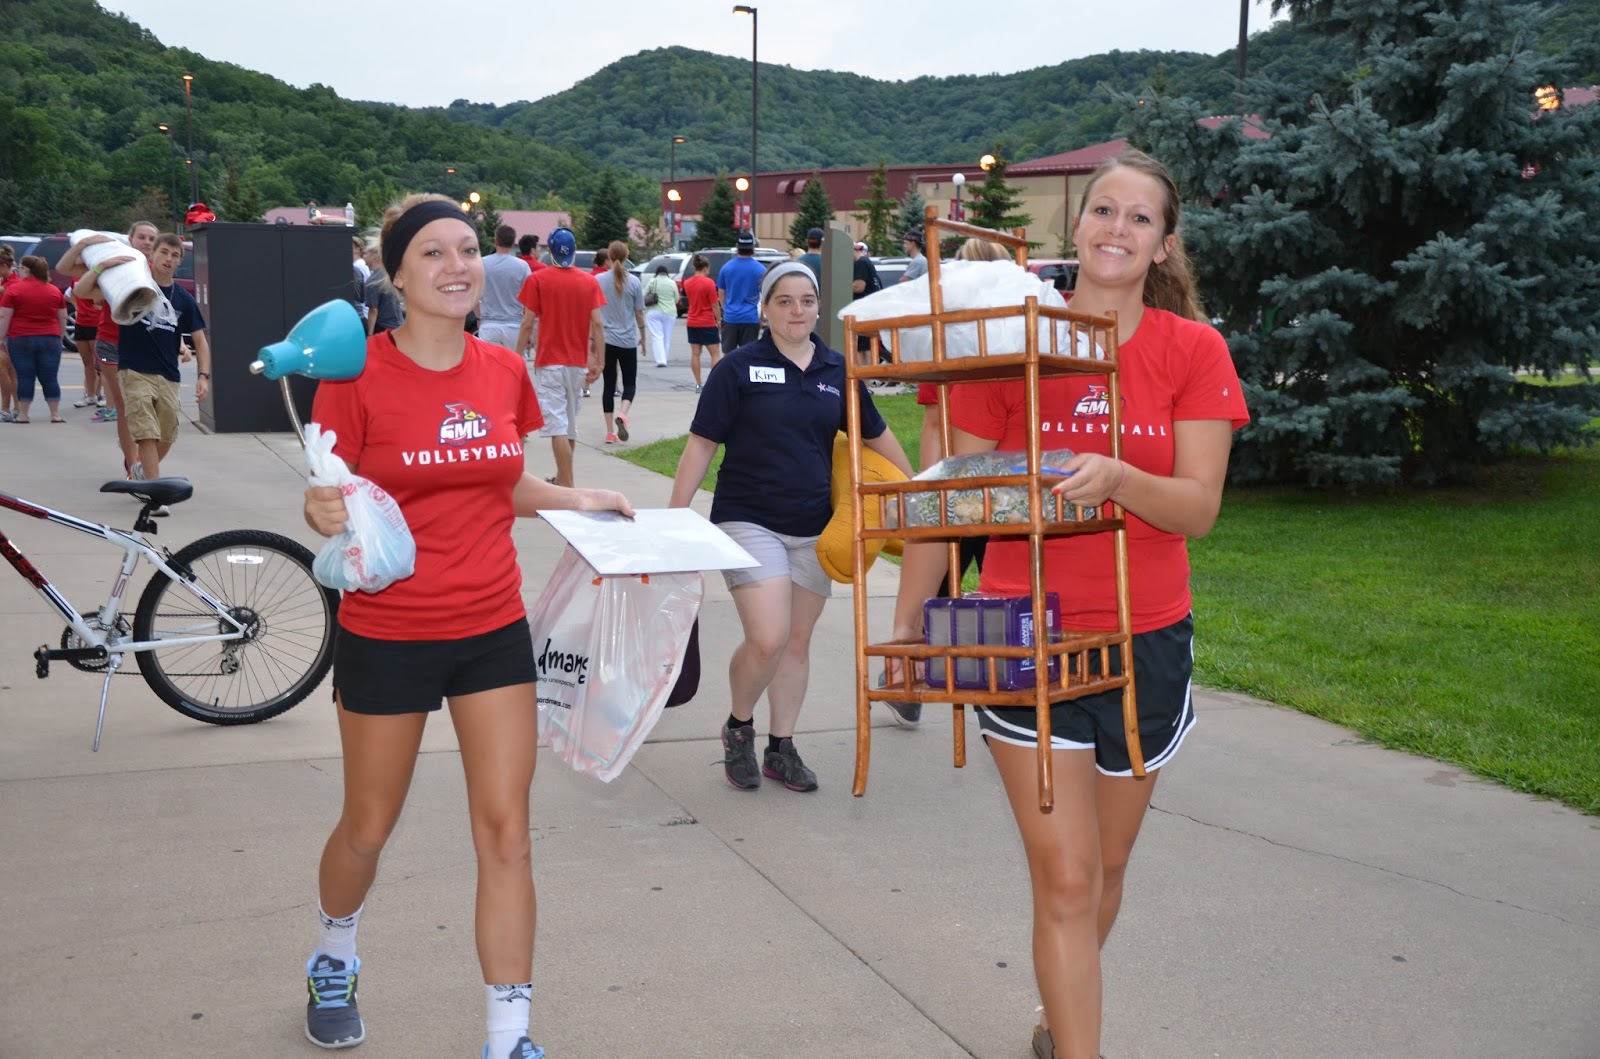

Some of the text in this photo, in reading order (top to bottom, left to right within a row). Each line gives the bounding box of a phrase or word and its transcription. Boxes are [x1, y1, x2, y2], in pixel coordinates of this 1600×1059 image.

[754, 369, 778, 381] Kim
[1041, 421, 1167, 437] OLLEYALL
[401, 441, 523, 467] VOLLEYBALL
